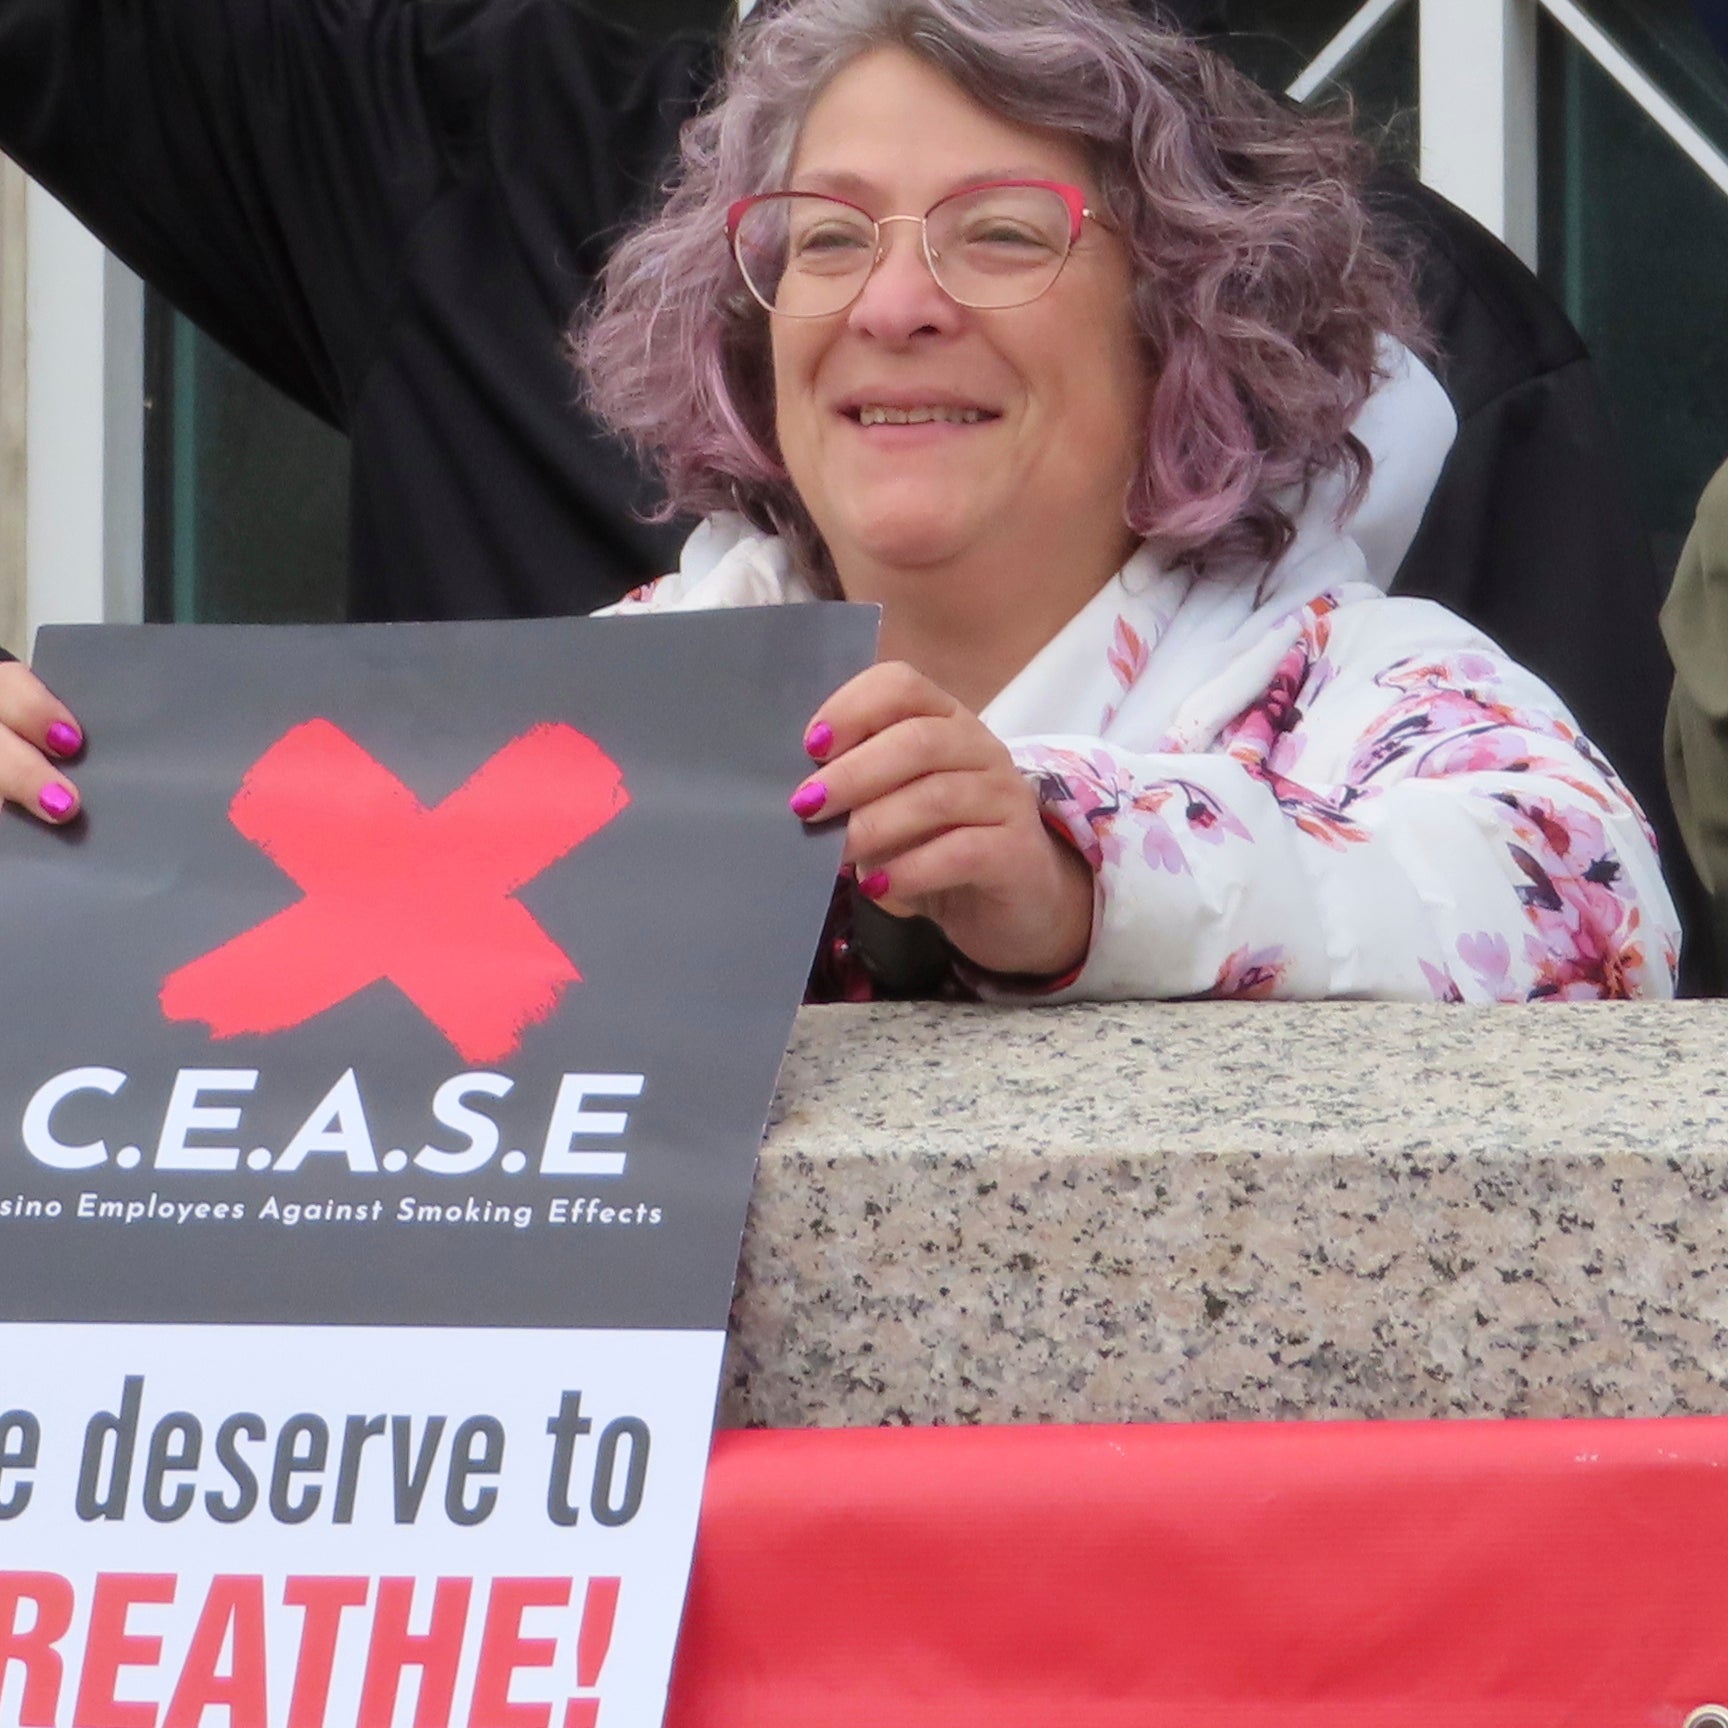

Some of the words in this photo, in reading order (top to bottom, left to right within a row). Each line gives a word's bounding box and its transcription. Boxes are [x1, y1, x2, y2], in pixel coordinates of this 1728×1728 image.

[21, 1066, 646, 1177] C.E.A.S.E
[77, 1193, 245, 1224] Employees
[258, 1195, 384, 1227] Against
[396, 1197, 532, 1228] Smoking
[548, 1199, 663, 1226] Effects
[74, 1374, 505, 1527] deserve
[546, 1390, 652, 1528] to
